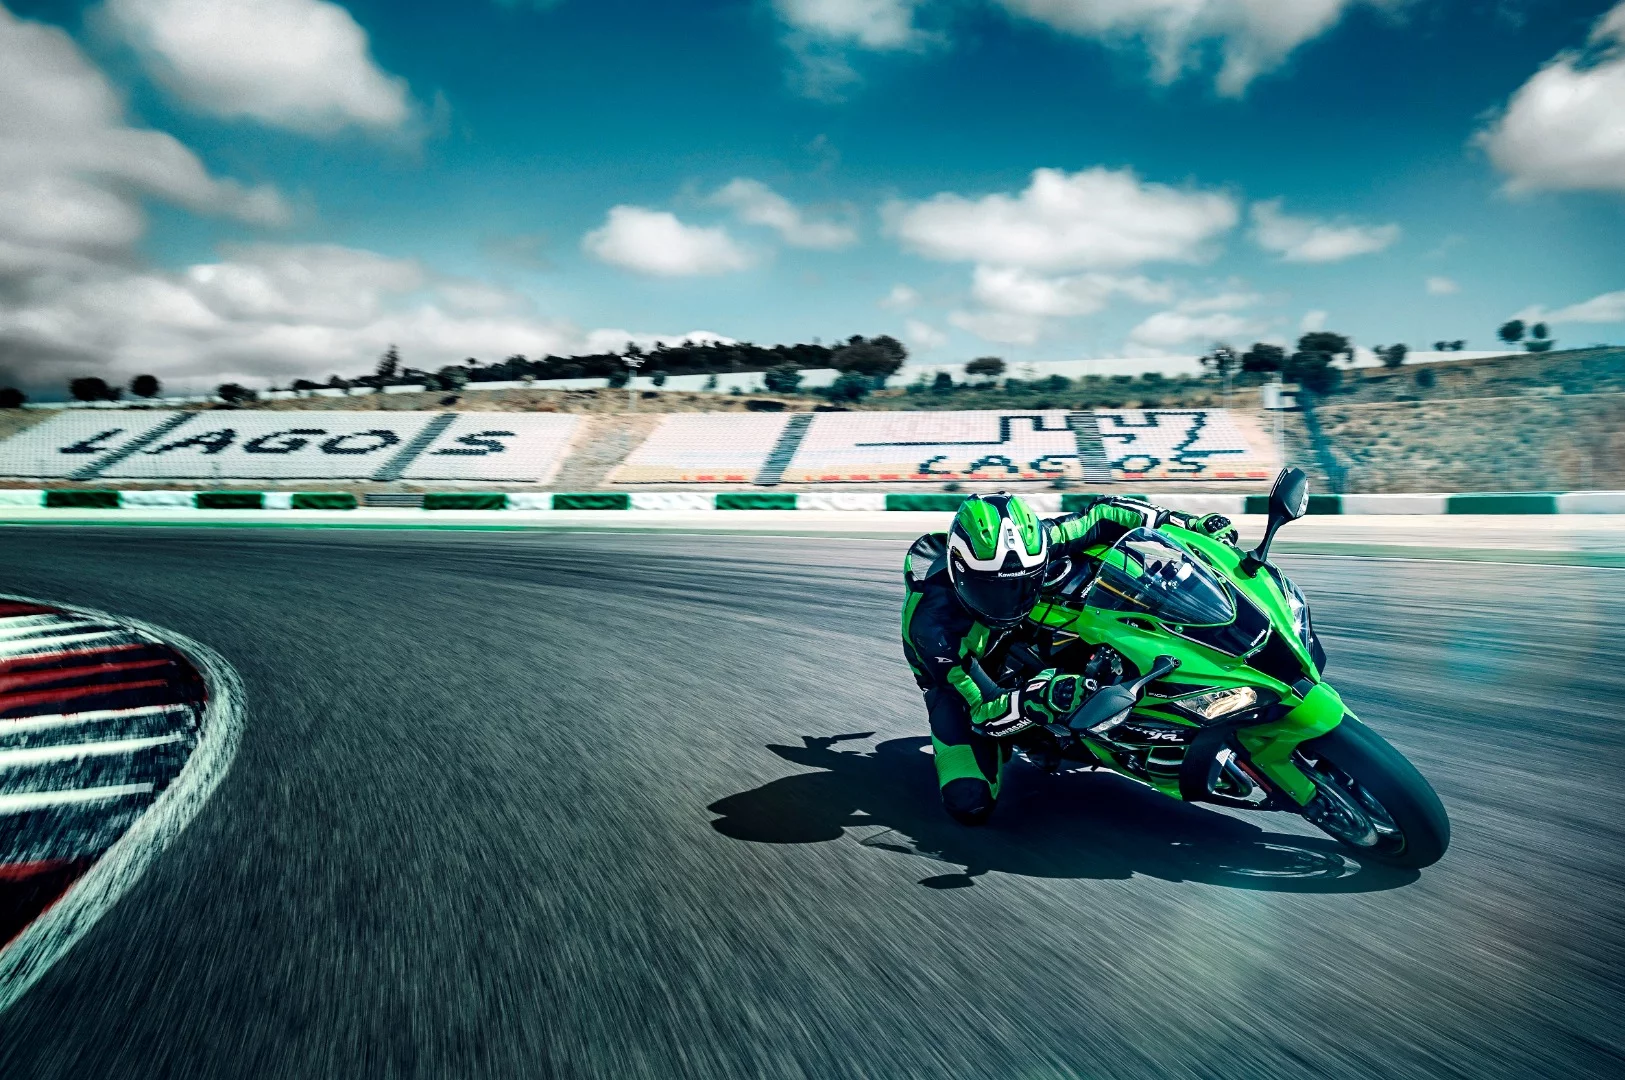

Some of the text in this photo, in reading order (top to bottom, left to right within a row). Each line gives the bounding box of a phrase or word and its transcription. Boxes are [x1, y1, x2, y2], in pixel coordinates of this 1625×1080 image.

[60, 428, 516, 455] LAGOS
[998, 570, 1026, 578] Kawasaki
[987, 716, 1032, 737] Kawasaki
